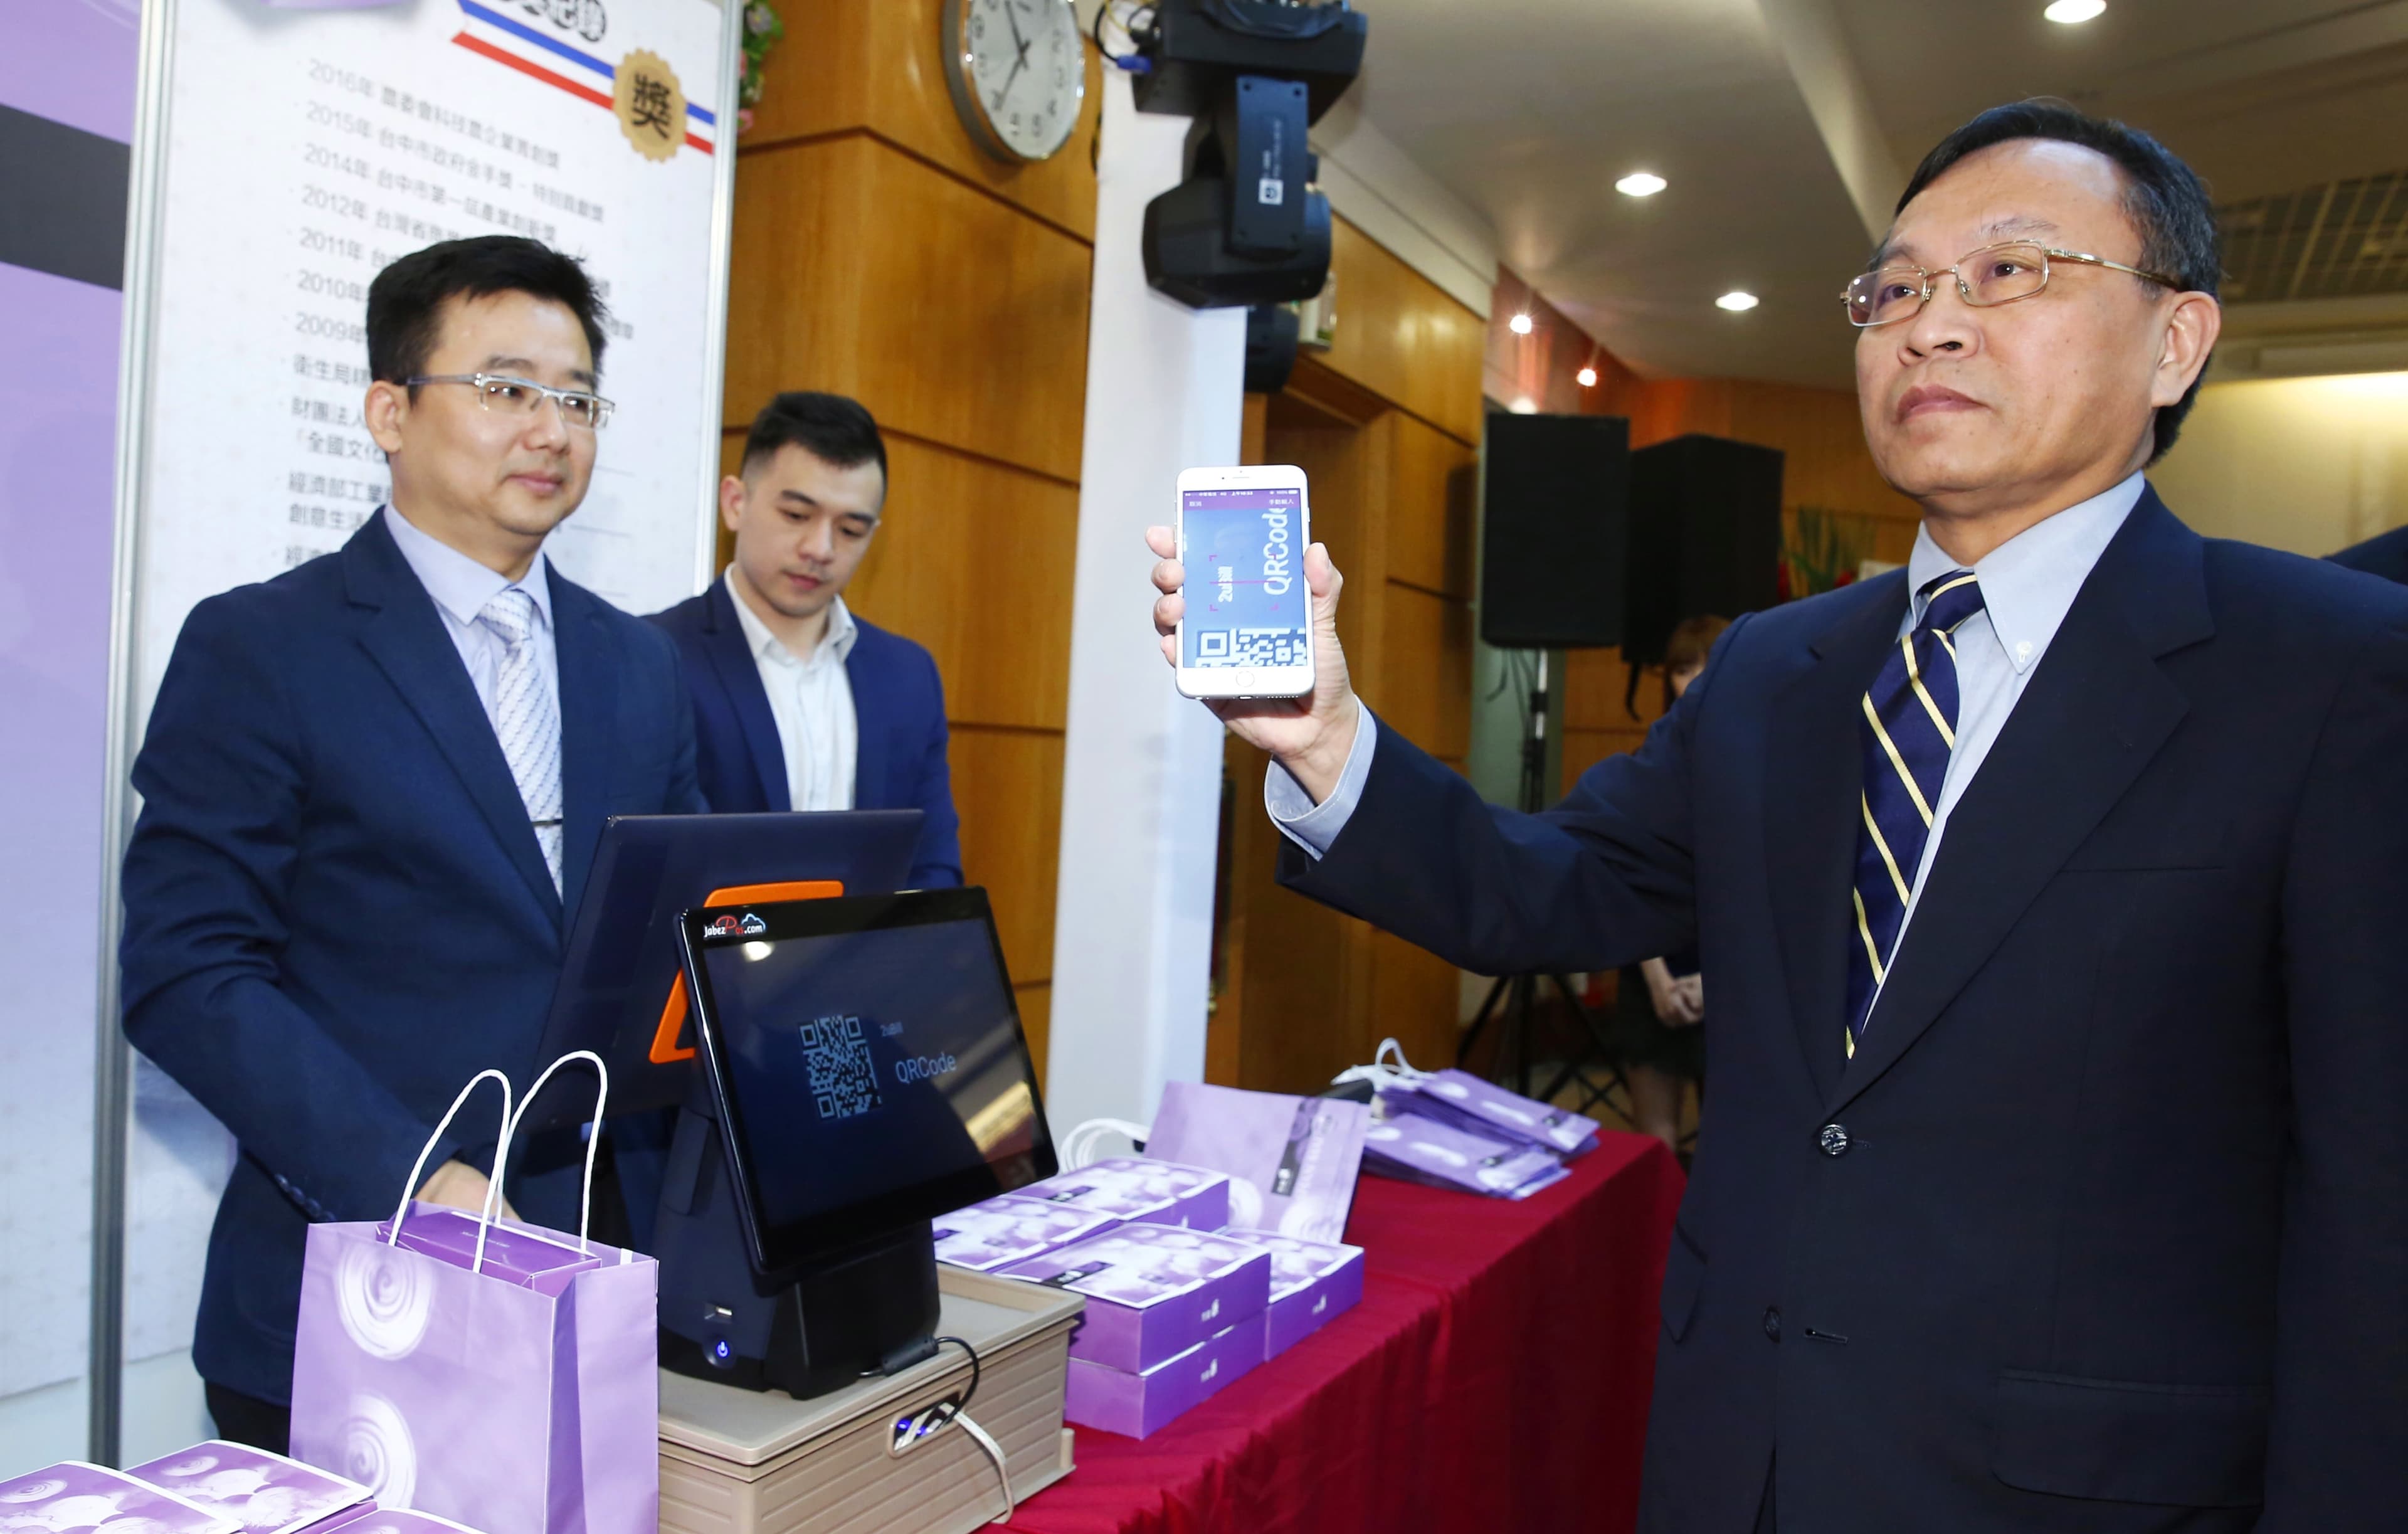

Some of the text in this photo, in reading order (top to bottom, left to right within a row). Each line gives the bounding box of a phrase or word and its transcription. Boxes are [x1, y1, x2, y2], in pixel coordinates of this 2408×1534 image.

[304, 142, 369, 179] 2014年
[301, 184, 367, 220] 2012年
[298, 226, 364, 260] 2011年
[895, 1051, 957, 1084] QRCode
